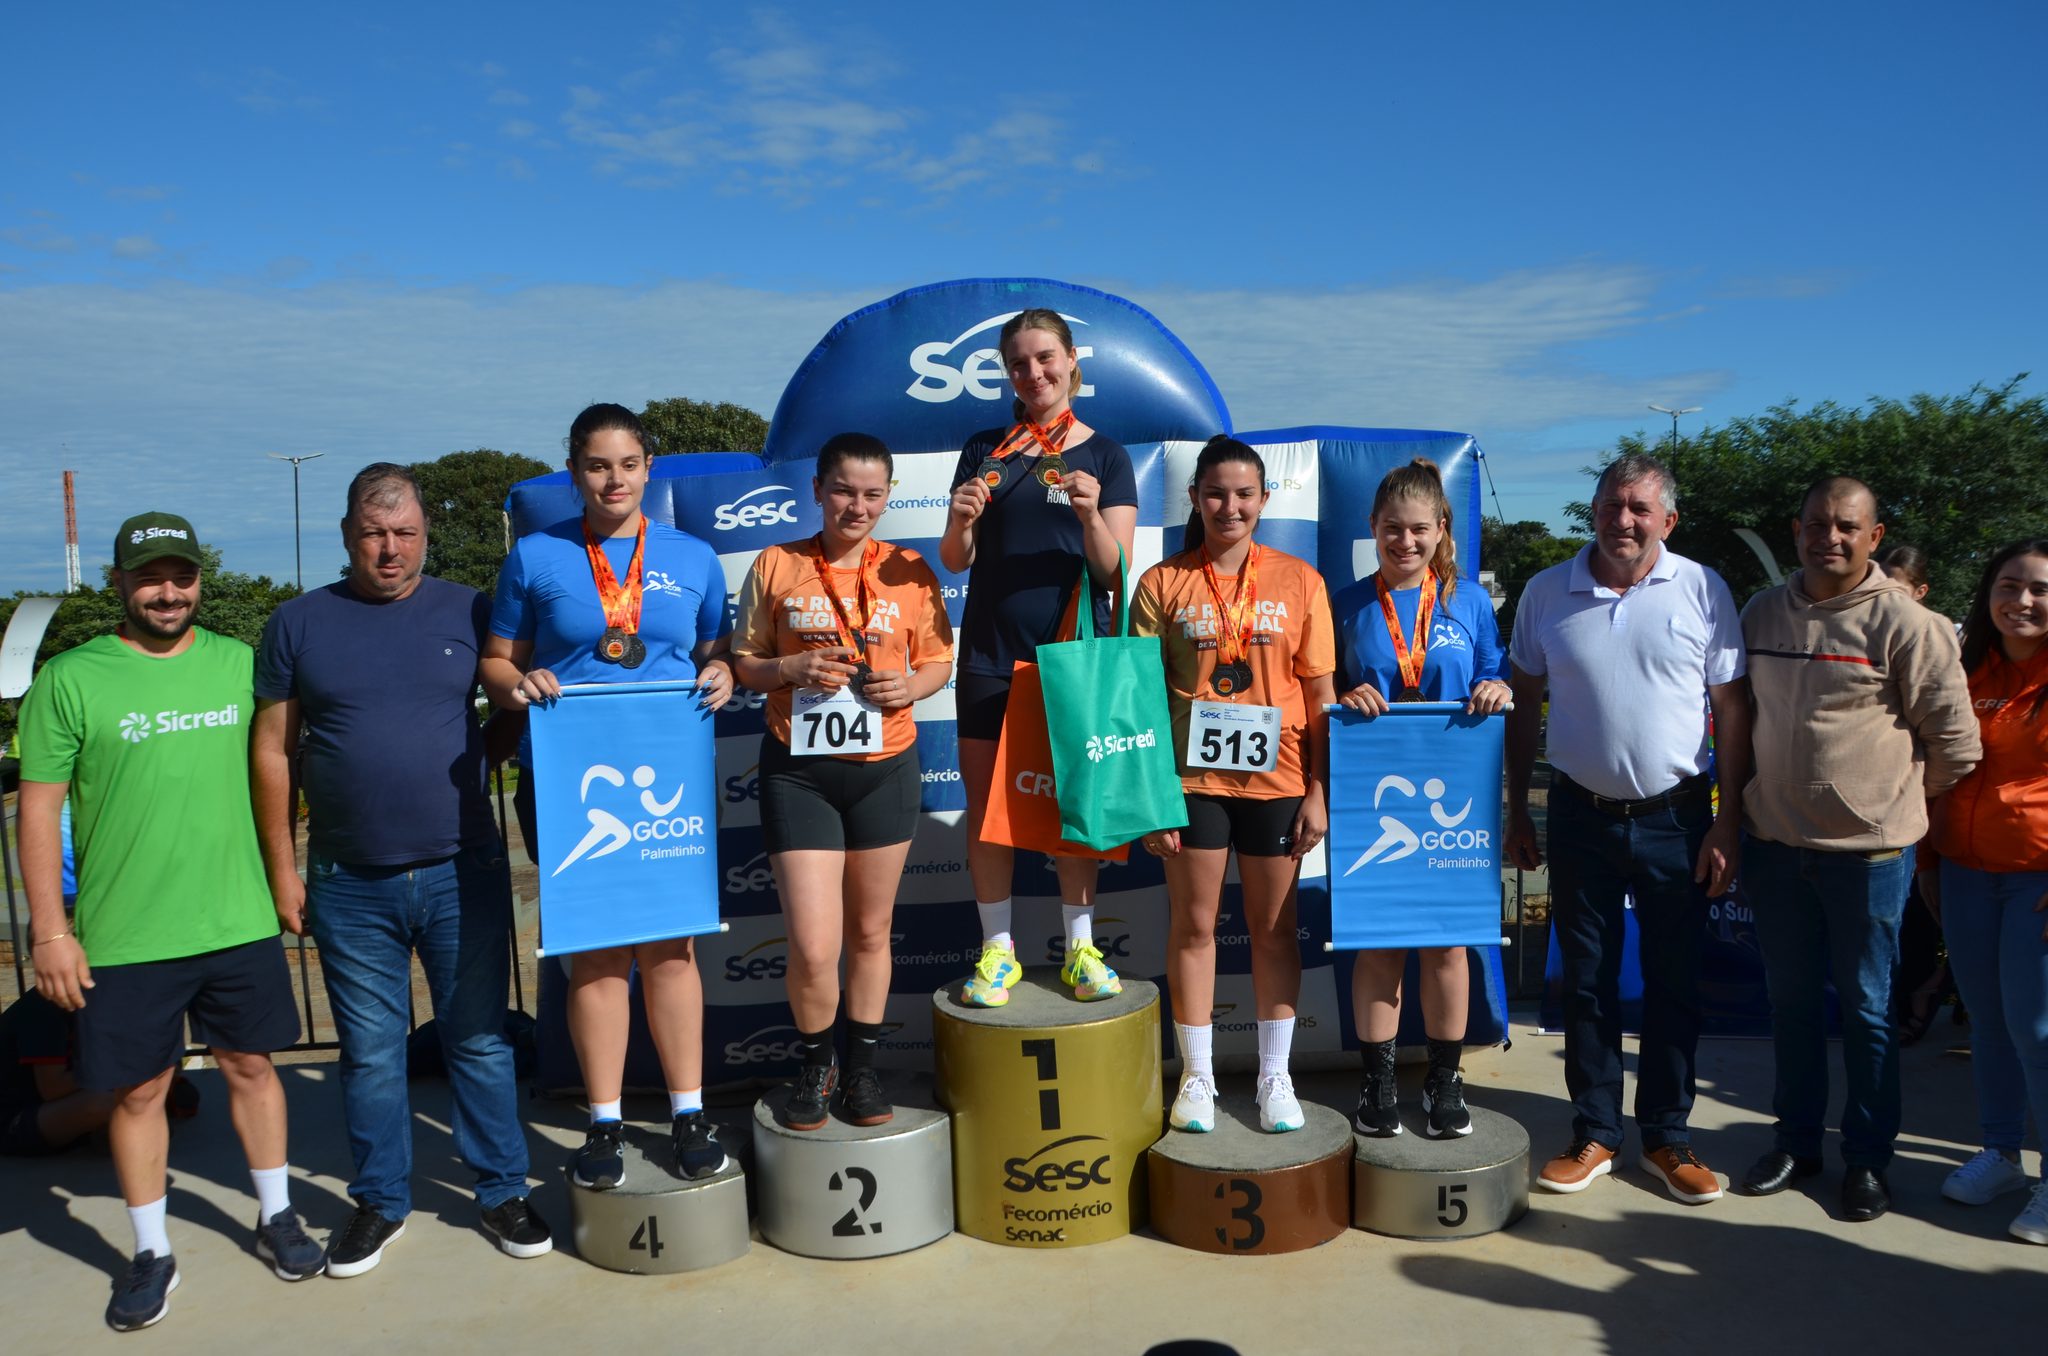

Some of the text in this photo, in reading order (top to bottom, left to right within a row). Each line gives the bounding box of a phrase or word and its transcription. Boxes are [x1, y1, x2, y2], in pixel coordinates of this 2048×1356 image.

[1283, 479, 1302, 490] RS
[713, 500, 798, 531] Sesc
[885, 496, 952, 509] comérci
[145, 527, 188, 540] Sicredi
[789, 611, 895, 634] REGIAL
[1777, 642, 1838, 654] PARIS
[155, 704, 239, 734] Sicredi
[1200, 710, 1220, 719] Sesc
[803, 711, 871, 748] 704
[1104, 729, 1156, 756] Sicredi
[1200, 728, 1268, 767] 513
[632, 816, 704, 842] GCOR
[1421, 829, 1490, 850] GCOR
[641, 844, 706, 861] Palmitinho
[1428, 856, 1491, 869] Palmitinho
[1046, 934, 1130, 963] Ssc
[724, 955, 787, 982] Ses
[1021, 1038, 1061, 1130] 1
[1003, 1154, 1112, 1193] Sesc
[828, 1166, 882, 1237] 2
[1003, 1200, 1112, 1223] Fecomércio
[1214, 1179, 1265, 1250] 3
[1437, 1184, 1468, 1228] 5
[628, 1215, 664, 1258] 4
[1005, 1225, 1065, 1242] Senac
